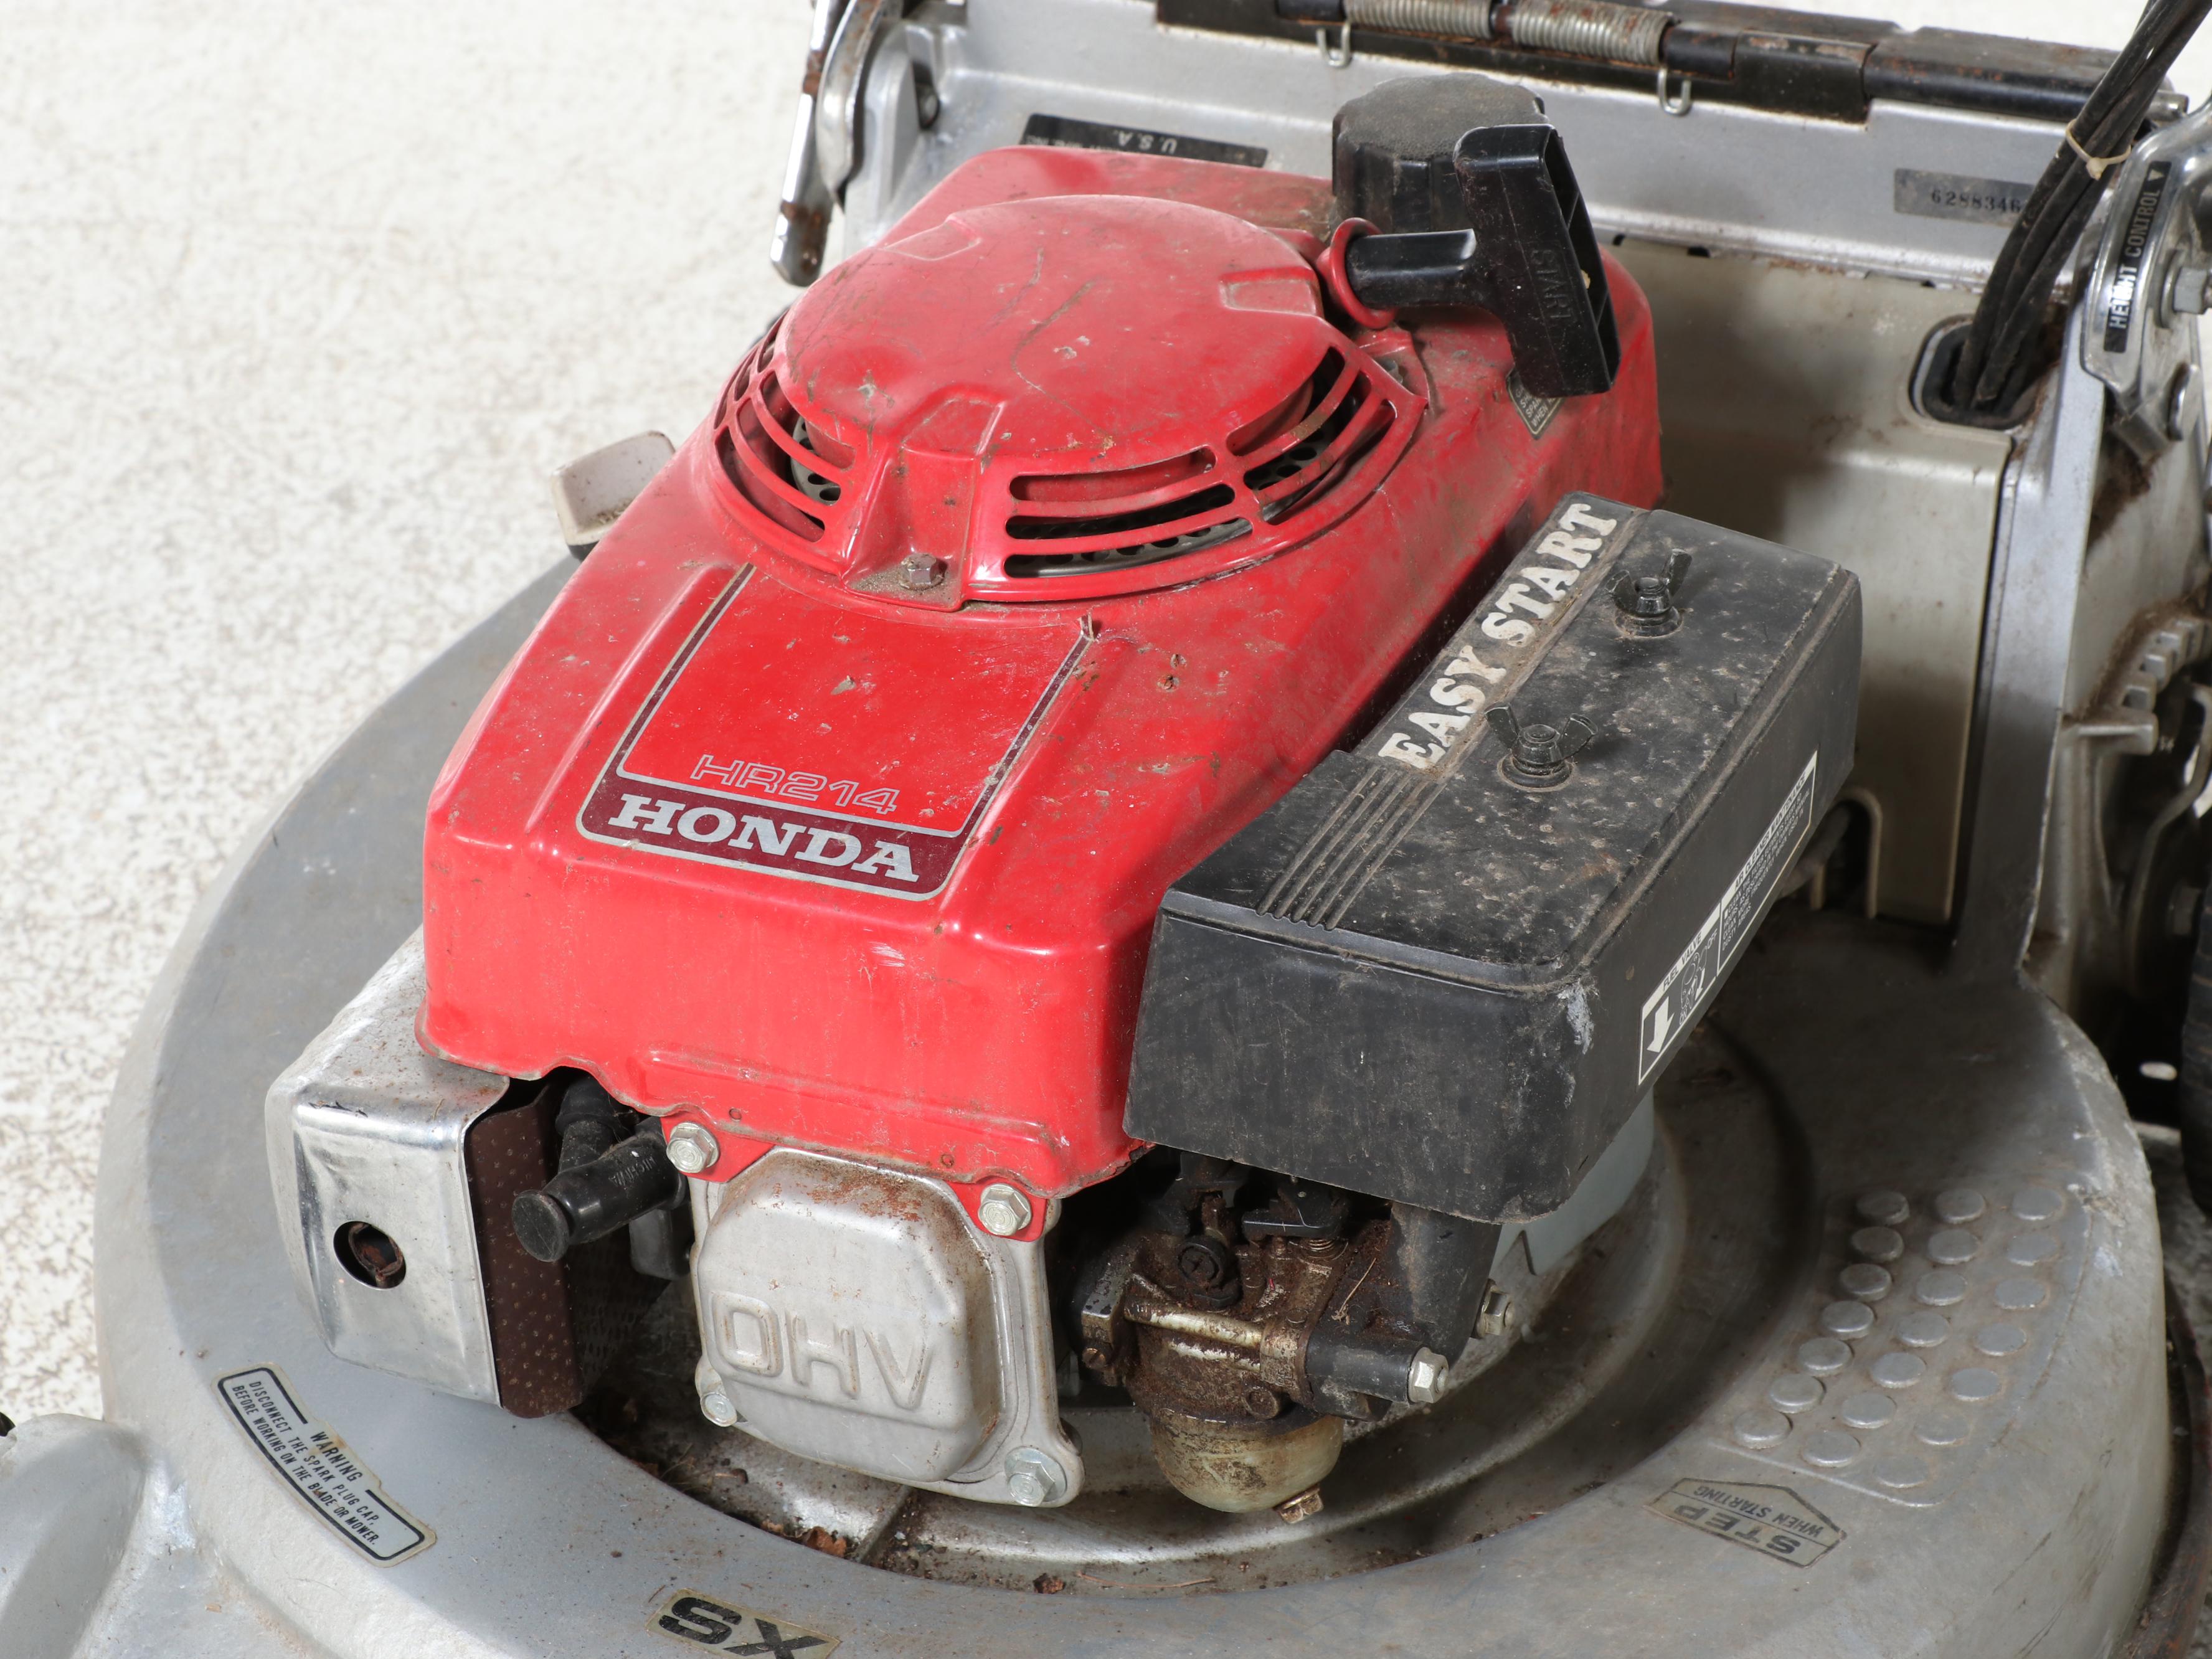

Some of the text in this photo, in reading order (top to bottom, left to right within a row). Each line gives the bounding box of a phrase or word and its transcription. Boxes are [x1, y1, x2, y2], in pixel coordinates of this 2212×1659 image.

[1113, 130, 1178, 154] U.S.A.
[2109, 190, 2160, 329] HEIGHT CONTROL
[1531, 405, 1549, 427] WHEN
[1378, 503, 1617, 768] EASY START
[690, 754, 900, 815] HR214
[608, 793, 919, 882] HONDA
[1735, 772, 1805, 892] AIR CLEANER MAINTENANCE
[1663, 930, 1703, 992] FUEL VALVE
[1707, 928, 1718, 949] OFF
[712, 1291, 933, 1411] OHV
[233, 1386, 379, 1545] BEFORE WORKING ON THE BLADE OR MOWER.
[249, 1381, 291, 1432] DISCONNECT
[288, 1437, 308, 1454] THE
[304, 1455, 335, 1482] SPARK
[333, 1485, 360, 1505] PLUG
[311, 1432, 362, 1483] WARNING
[1673, 1505, 1800, 1554] STEP
[1693, 1486, 1824, 1537] WHEN STARTING
[659, 1597, 828, 1659] SX
